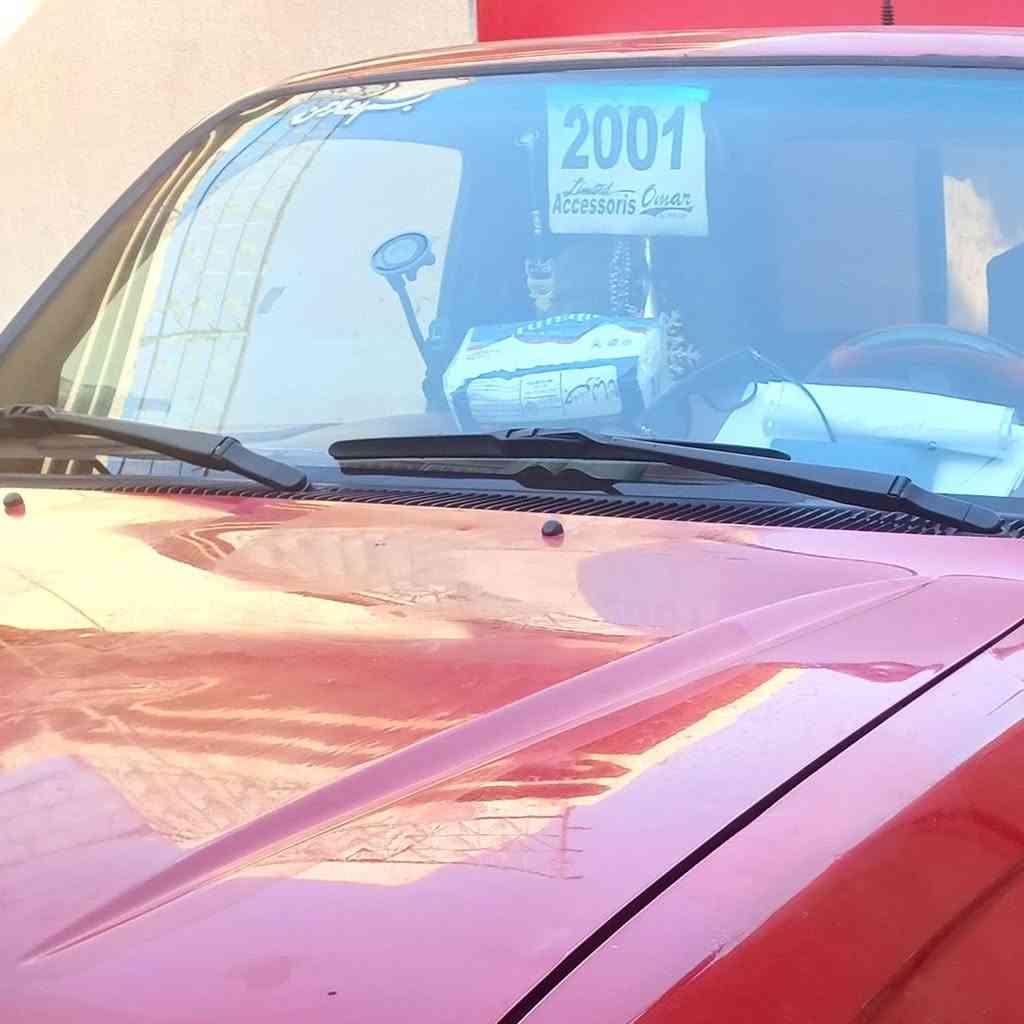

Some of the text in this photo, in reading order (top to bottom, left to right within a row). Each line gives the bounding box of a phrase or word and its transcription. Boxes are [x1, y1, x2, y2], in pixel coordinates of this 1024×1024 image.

[561, 105, 685, 171] 2001
[552, 184, 694, 215] Accessoris Omar
